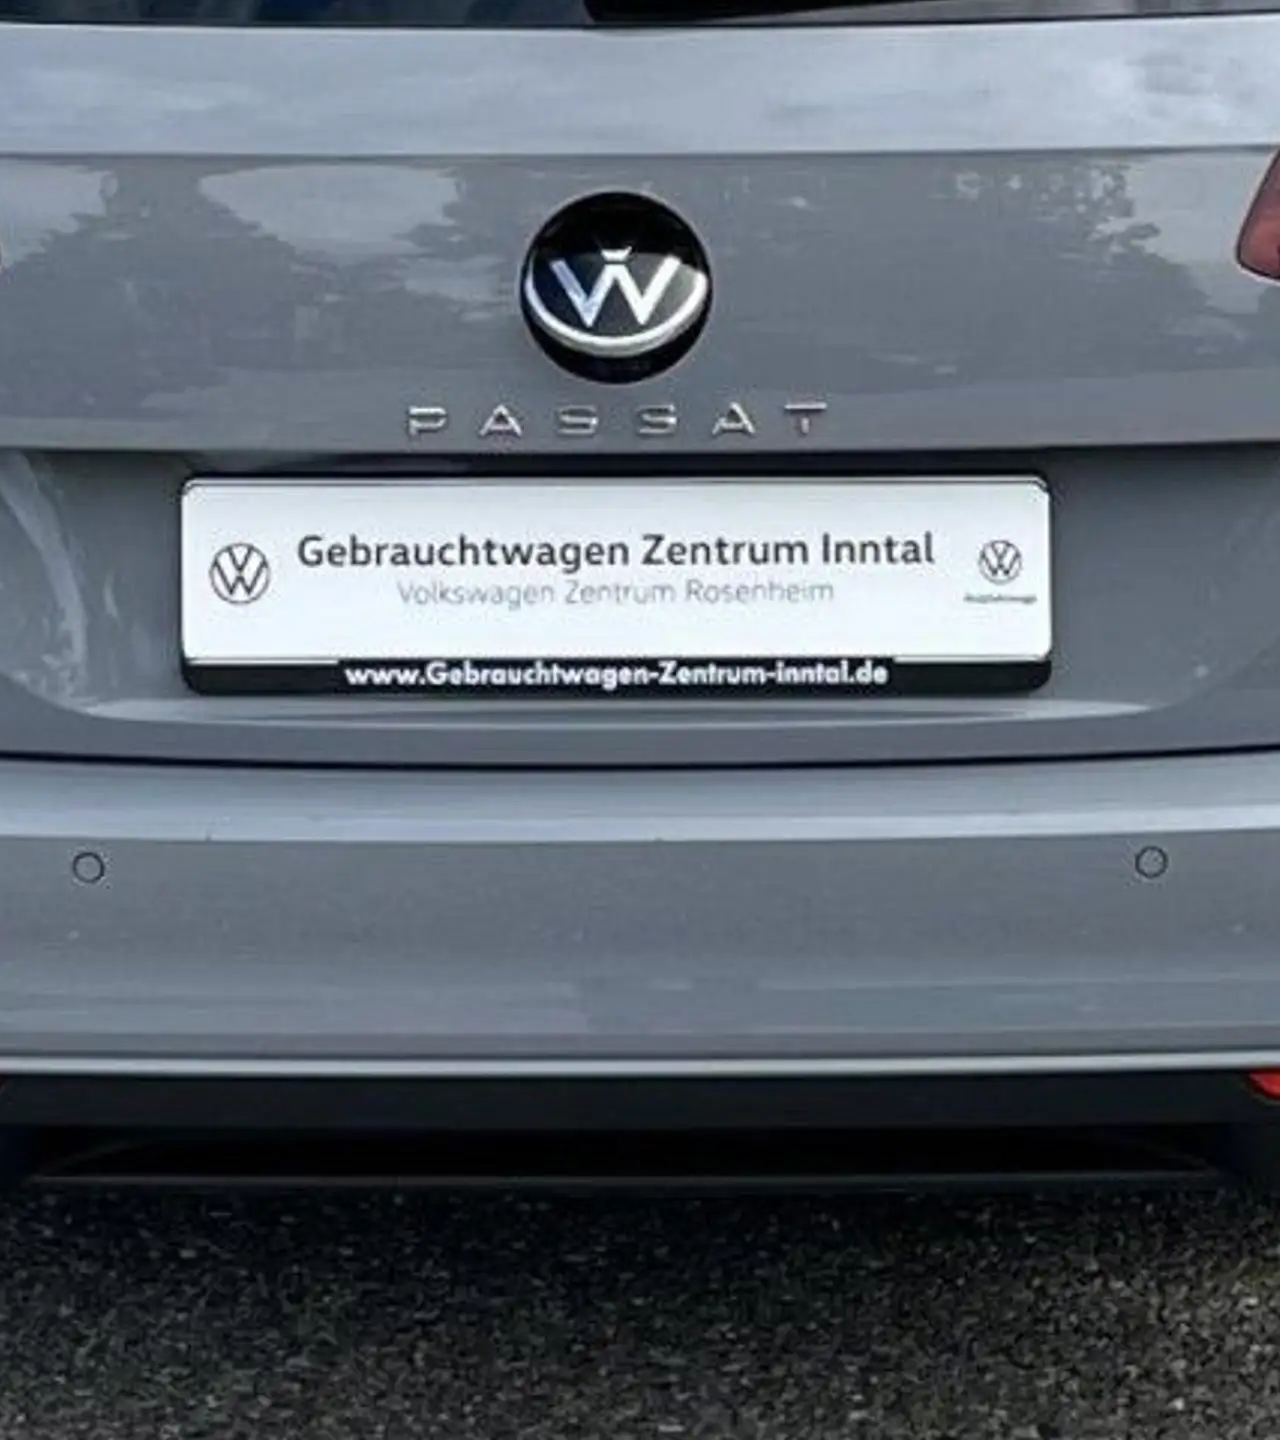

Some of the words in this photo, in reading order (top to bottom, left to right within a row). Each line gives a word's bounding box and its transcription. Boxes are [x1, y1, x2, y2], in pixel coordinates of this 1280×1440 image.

[407, 402, 828, 437] PASSAT
[297, 533, 629, 574] Gebrauchtwagen
[641, 533, 809, 566] Zentrum
[822, 530, 935, 565] Inntal
[396, 578, 555, 610] Volkswagen
[564, 578, 676, 605] Zentrum
[685, 578, 834, 605] Rosenheim
